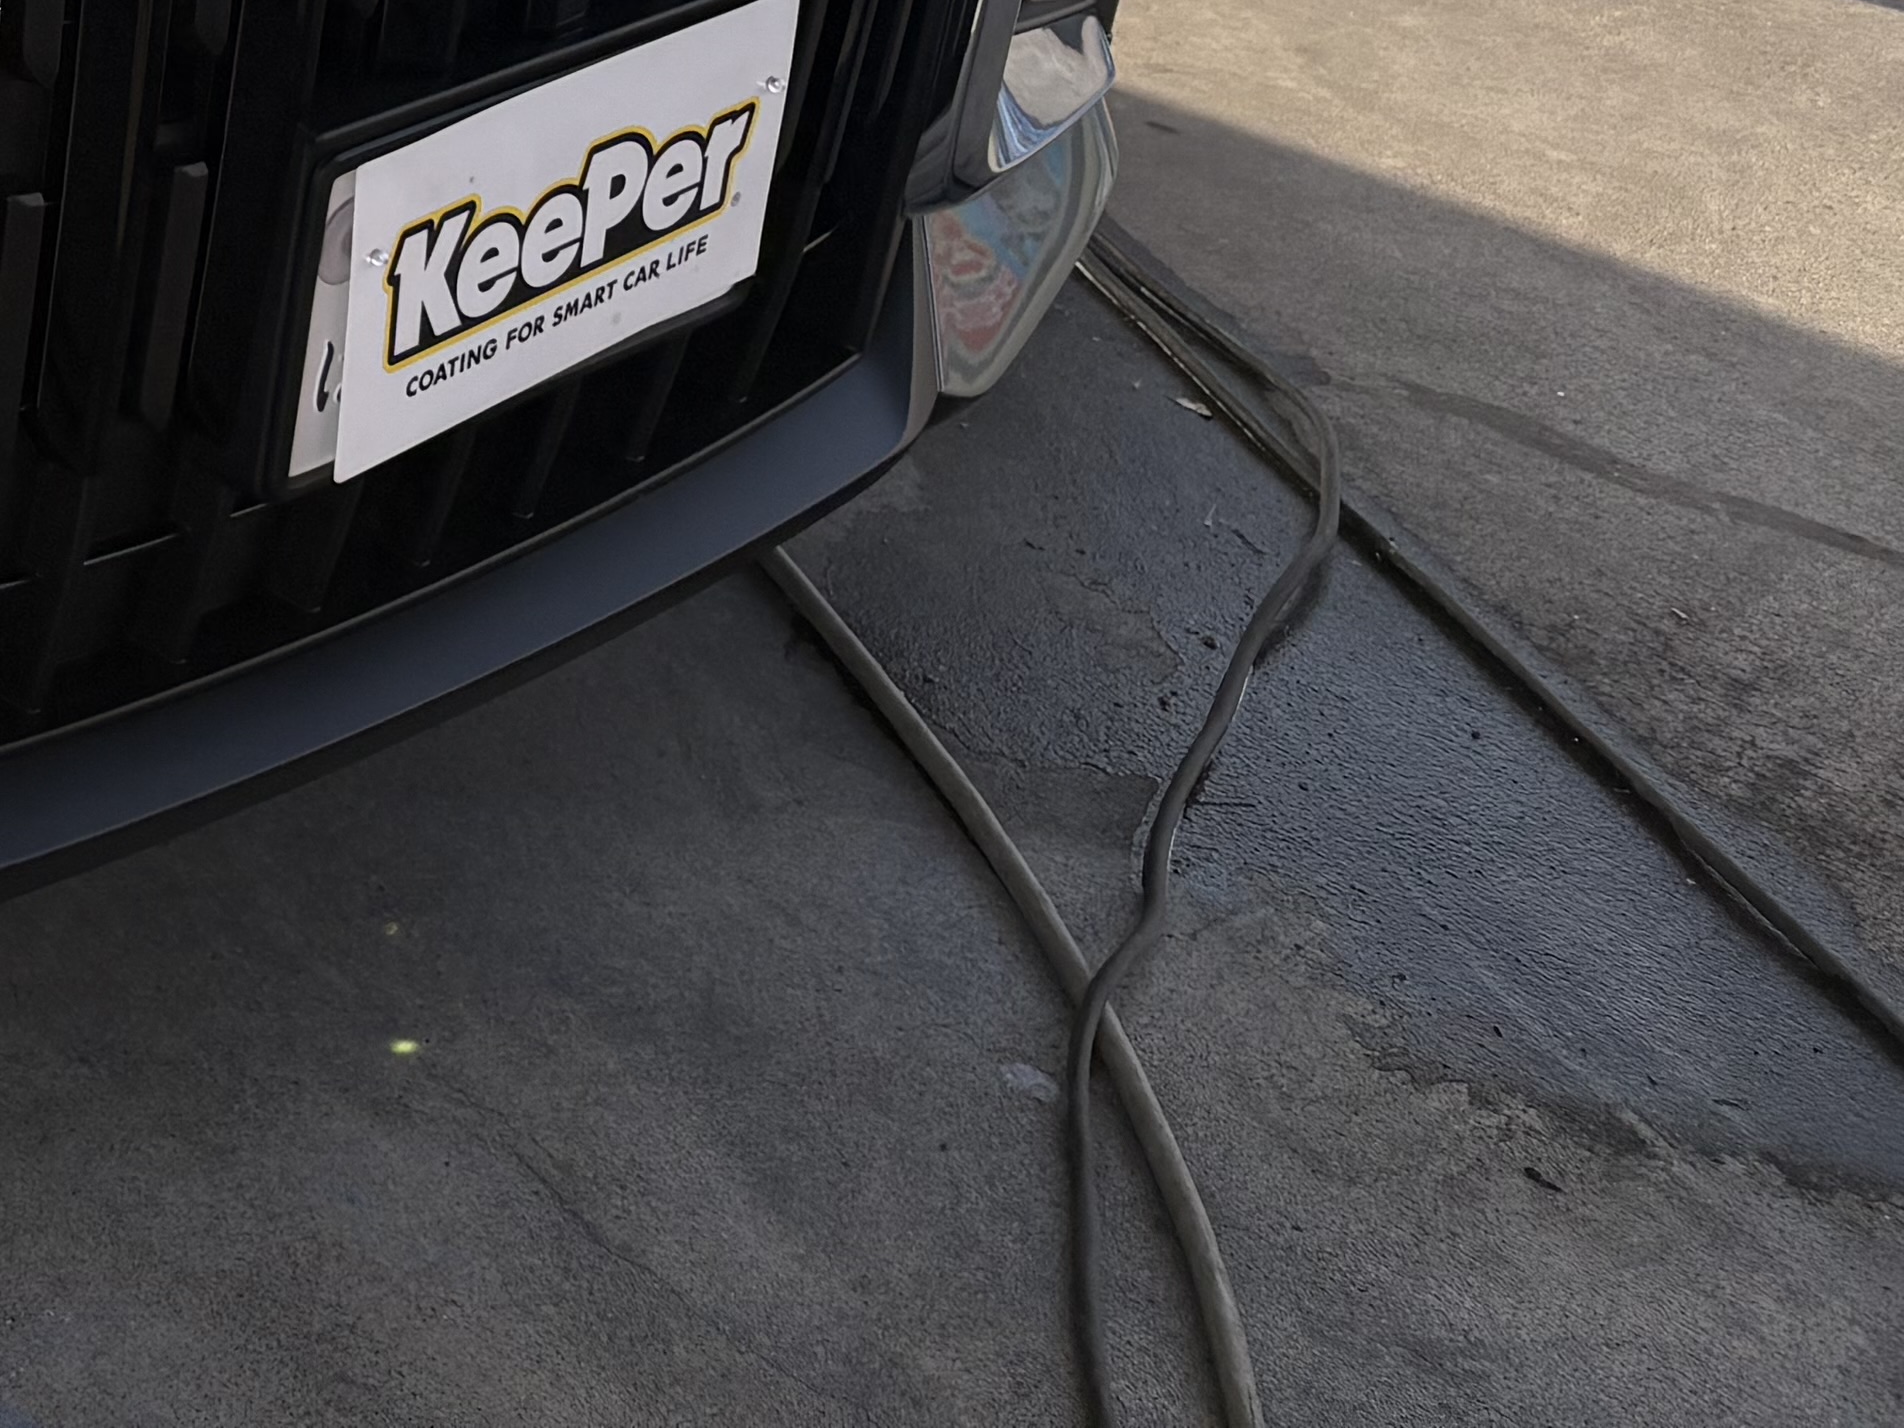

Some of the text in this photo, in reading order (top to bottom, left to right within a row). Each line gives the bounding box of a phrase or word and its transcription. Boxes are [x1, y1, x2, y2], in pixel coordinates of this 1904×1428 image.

[385, 99, 758, 368] KeePer
[405, 233, 709, 398] COATING FOR SMART CAR LIFE
